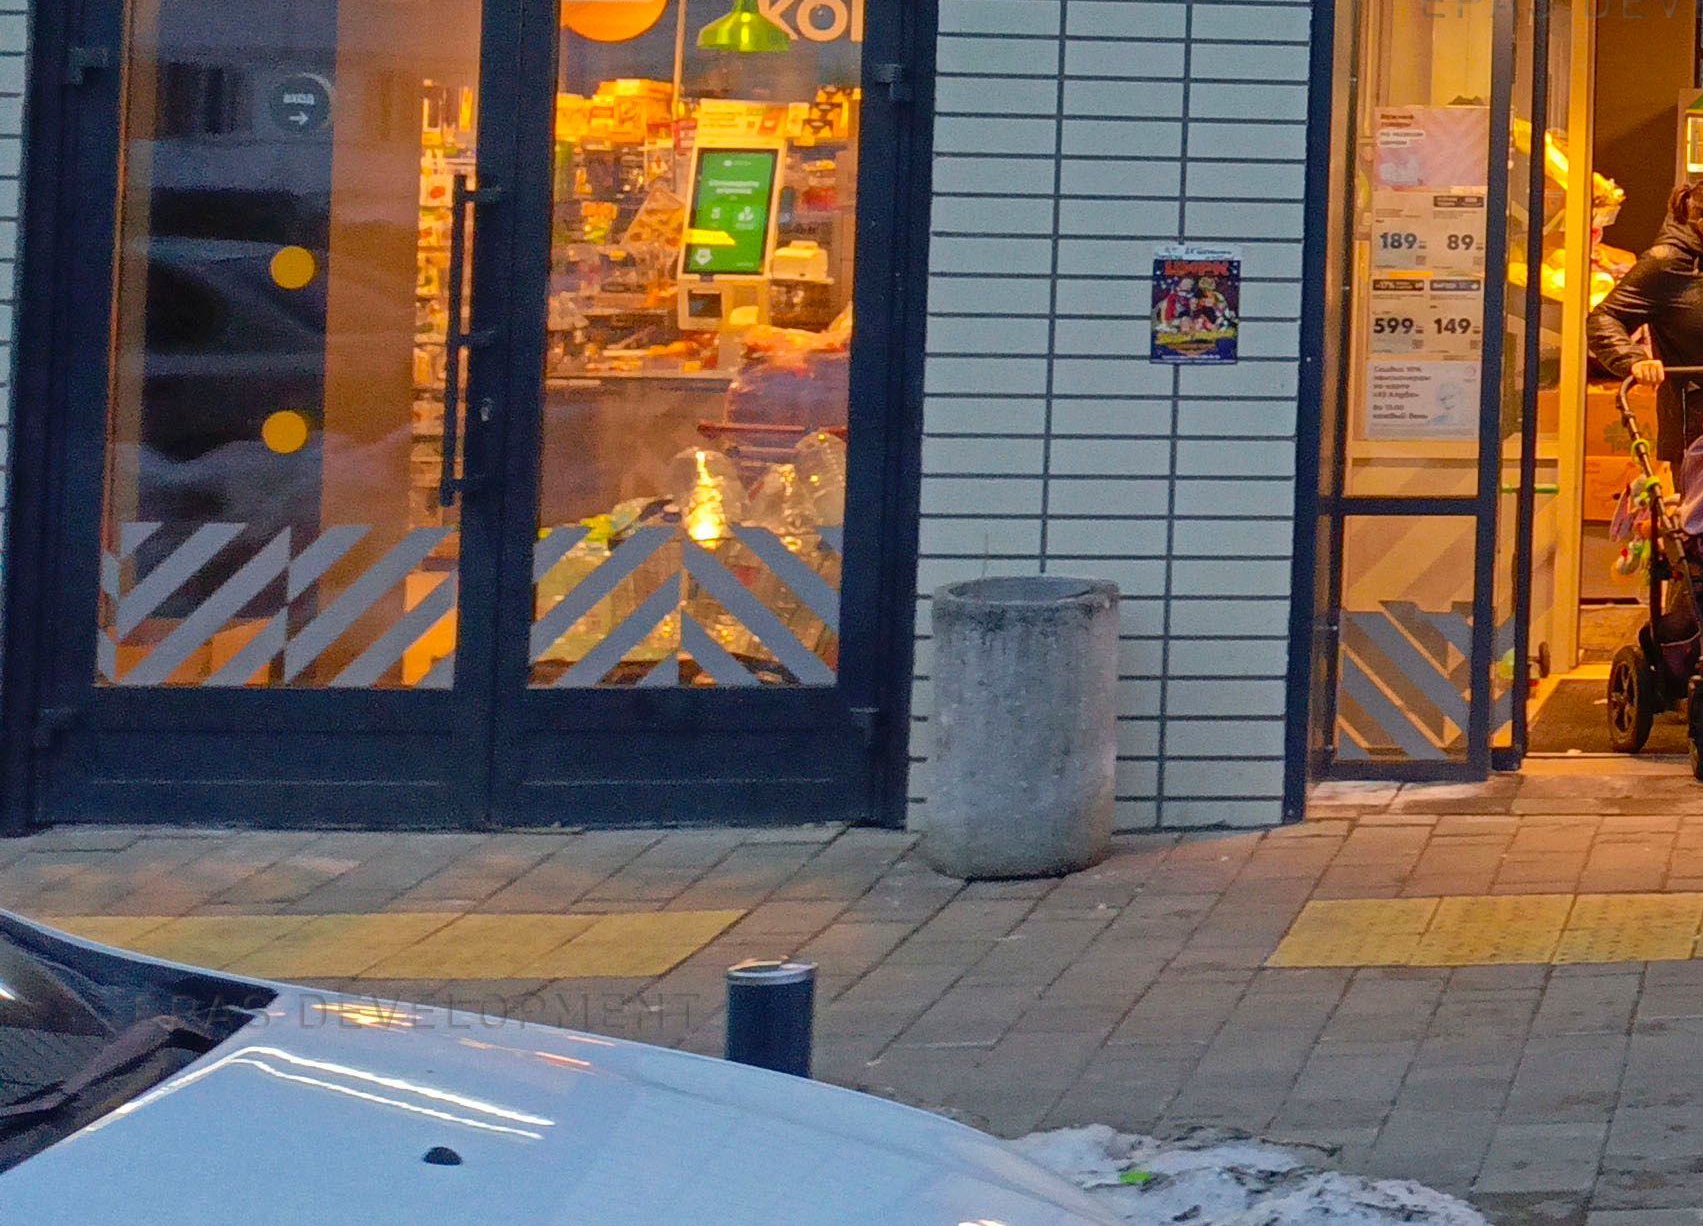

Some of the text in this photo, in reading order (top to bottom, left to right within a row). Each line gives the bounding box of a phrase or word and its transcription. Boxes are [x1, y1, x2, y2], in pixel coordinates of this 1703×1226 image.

[1380, 232, 1417, 249] 189
[1447, 234, 1474, 251] 89
[1373, 317, 1414, 334] 599
[1433, 317, 1471, 334] 149
